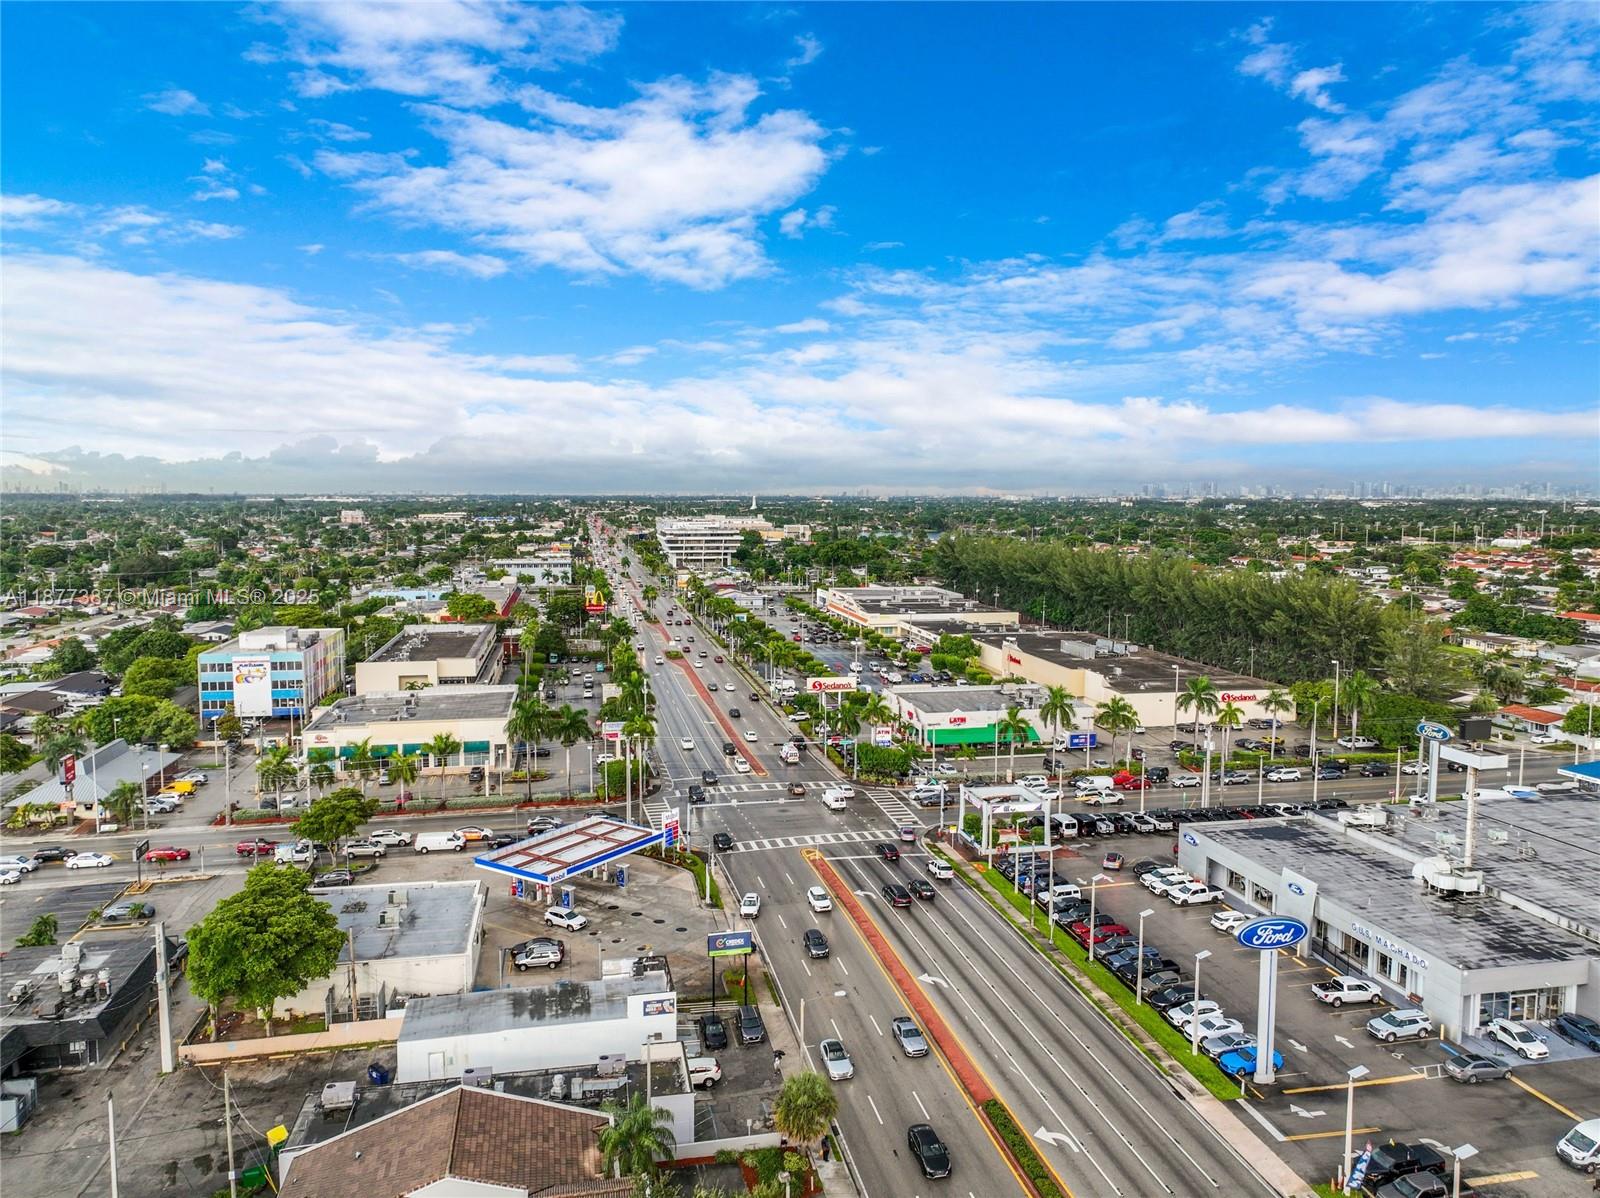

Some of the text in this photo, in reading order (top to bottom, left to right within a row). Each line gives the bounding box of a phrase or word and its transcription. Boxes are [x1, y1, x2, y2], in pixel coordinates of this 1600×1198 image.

[823, 682, 852, 690] Sedano's
[1231, 693, 1257, 702] Sedano's
[949, 716, 966, 724] LATIN
[1423, 725, 1444, 738] Ford
[1253, 925, 1295, 945] Ford
[1351, 922, 1428, 969] GUS MACHADO
